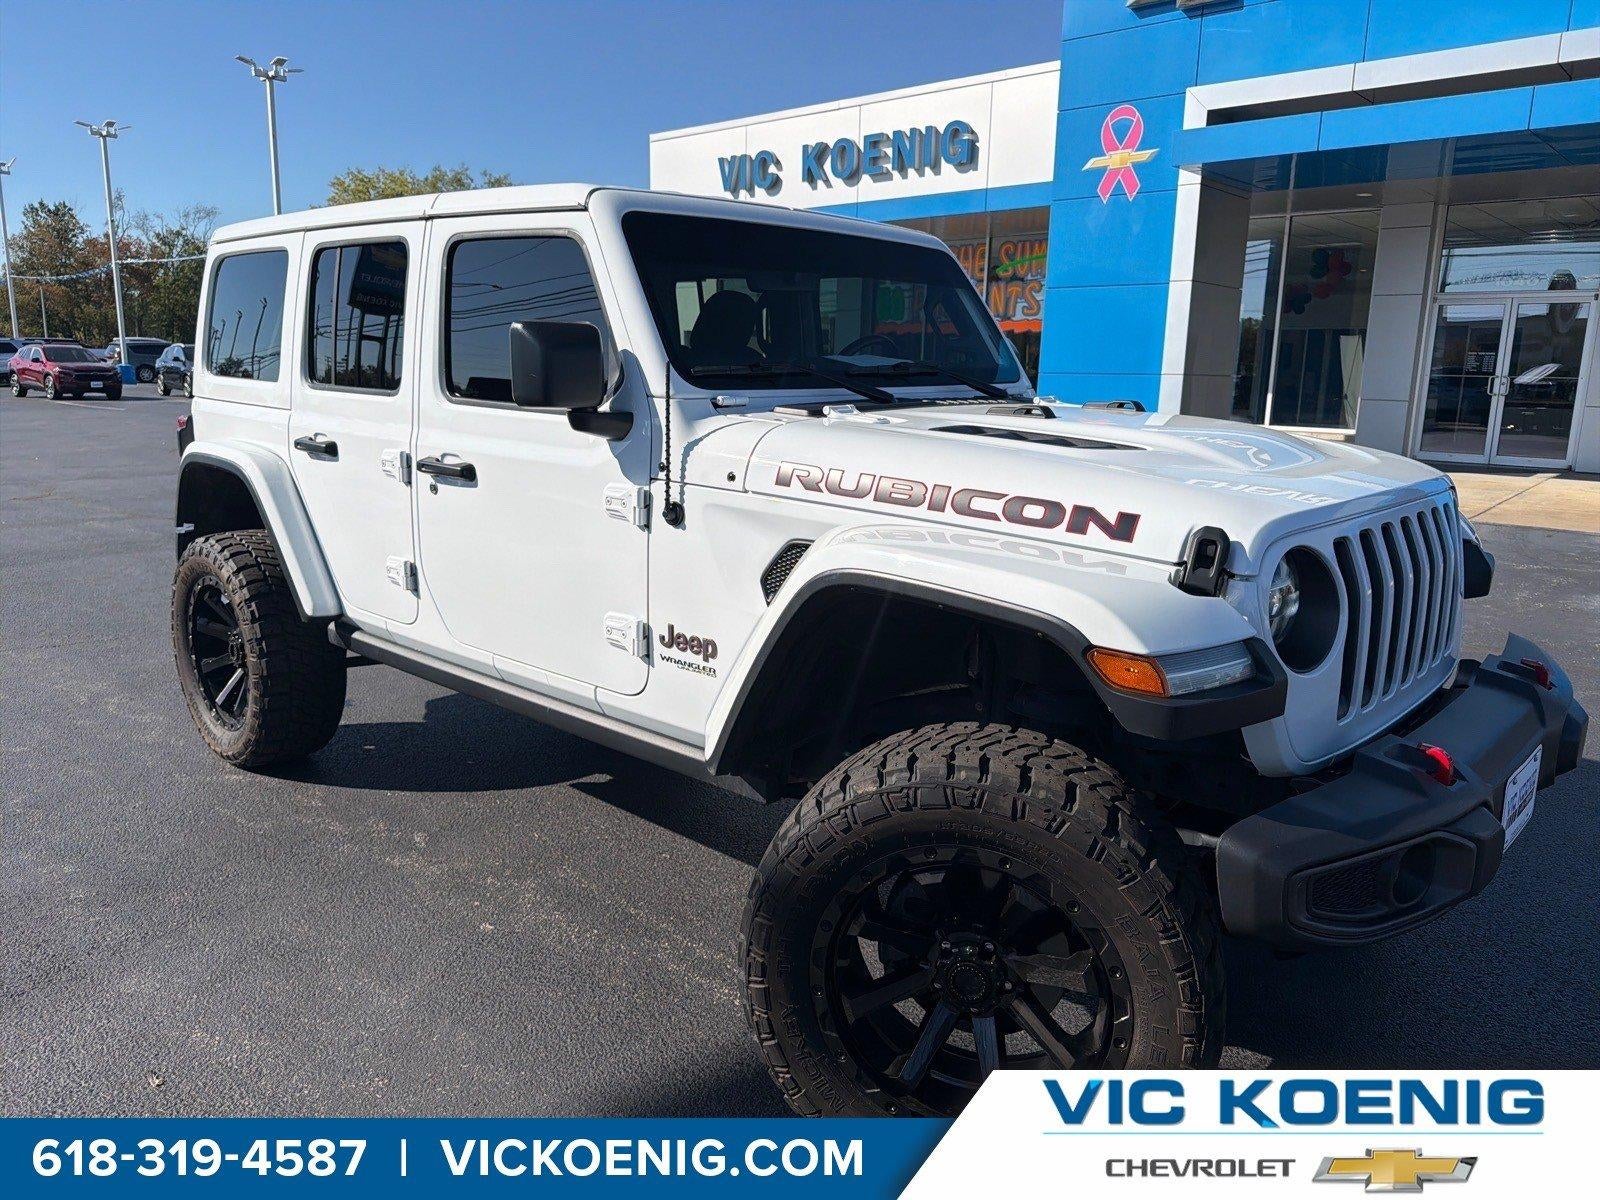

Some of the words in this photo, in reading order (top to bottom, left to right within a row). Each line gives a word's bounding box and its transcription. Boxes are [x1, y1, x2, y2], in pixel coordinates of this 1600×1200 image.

[717, 150, 783, 198] VIC
[801, 120, 979, 189] KOENIG
[775, 461, 1141, 543] RUBICON
[658, 623, 718, 663] Jeep
[659, 653, 717, 675] WRANGLER
